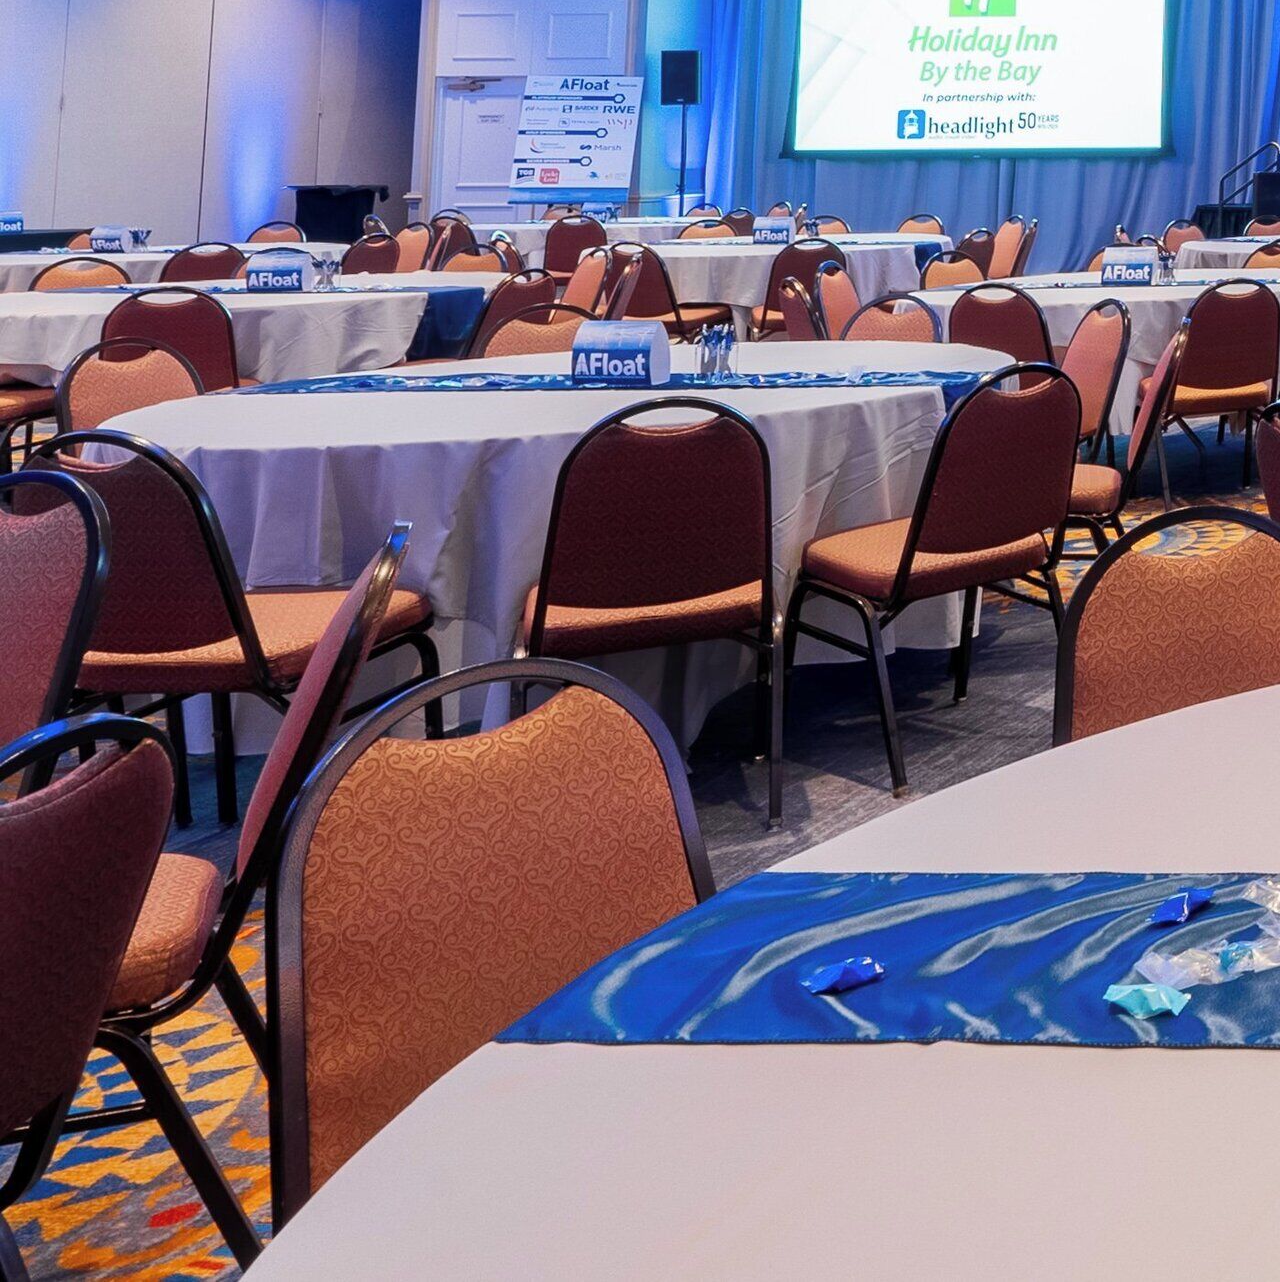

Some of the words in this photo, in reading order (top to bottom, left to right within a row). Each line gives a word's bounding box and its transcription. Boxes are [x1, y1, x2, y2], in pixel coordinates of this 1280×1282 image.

[908, 25, 1013, 58] Holiday
[1015, 25, 1059, 52] Inn
[919, 61, 948, 88] By
[954, 60, 992, 81] the
[997, 60, 1042, 87] Bay
[560, 78, 610, 91] AFloat
[922, 93, 934, 103] In
[936, 93, 1004, 104] partnership
[1007, 92, 1037, 102] with:
[602, 105, 637, 115] RWE
[928, 116, 1015, 140] headlight
[1017, 112, 1037, 130] 50
[1038, 114, 1060, 123] YEARS
[755, 229, 788, 242] AFloat
[248, 271, 300, 287] AFloat
[1103, 264, 1151, 281] AFloat
[574, 352, 646, 376] AFloat
